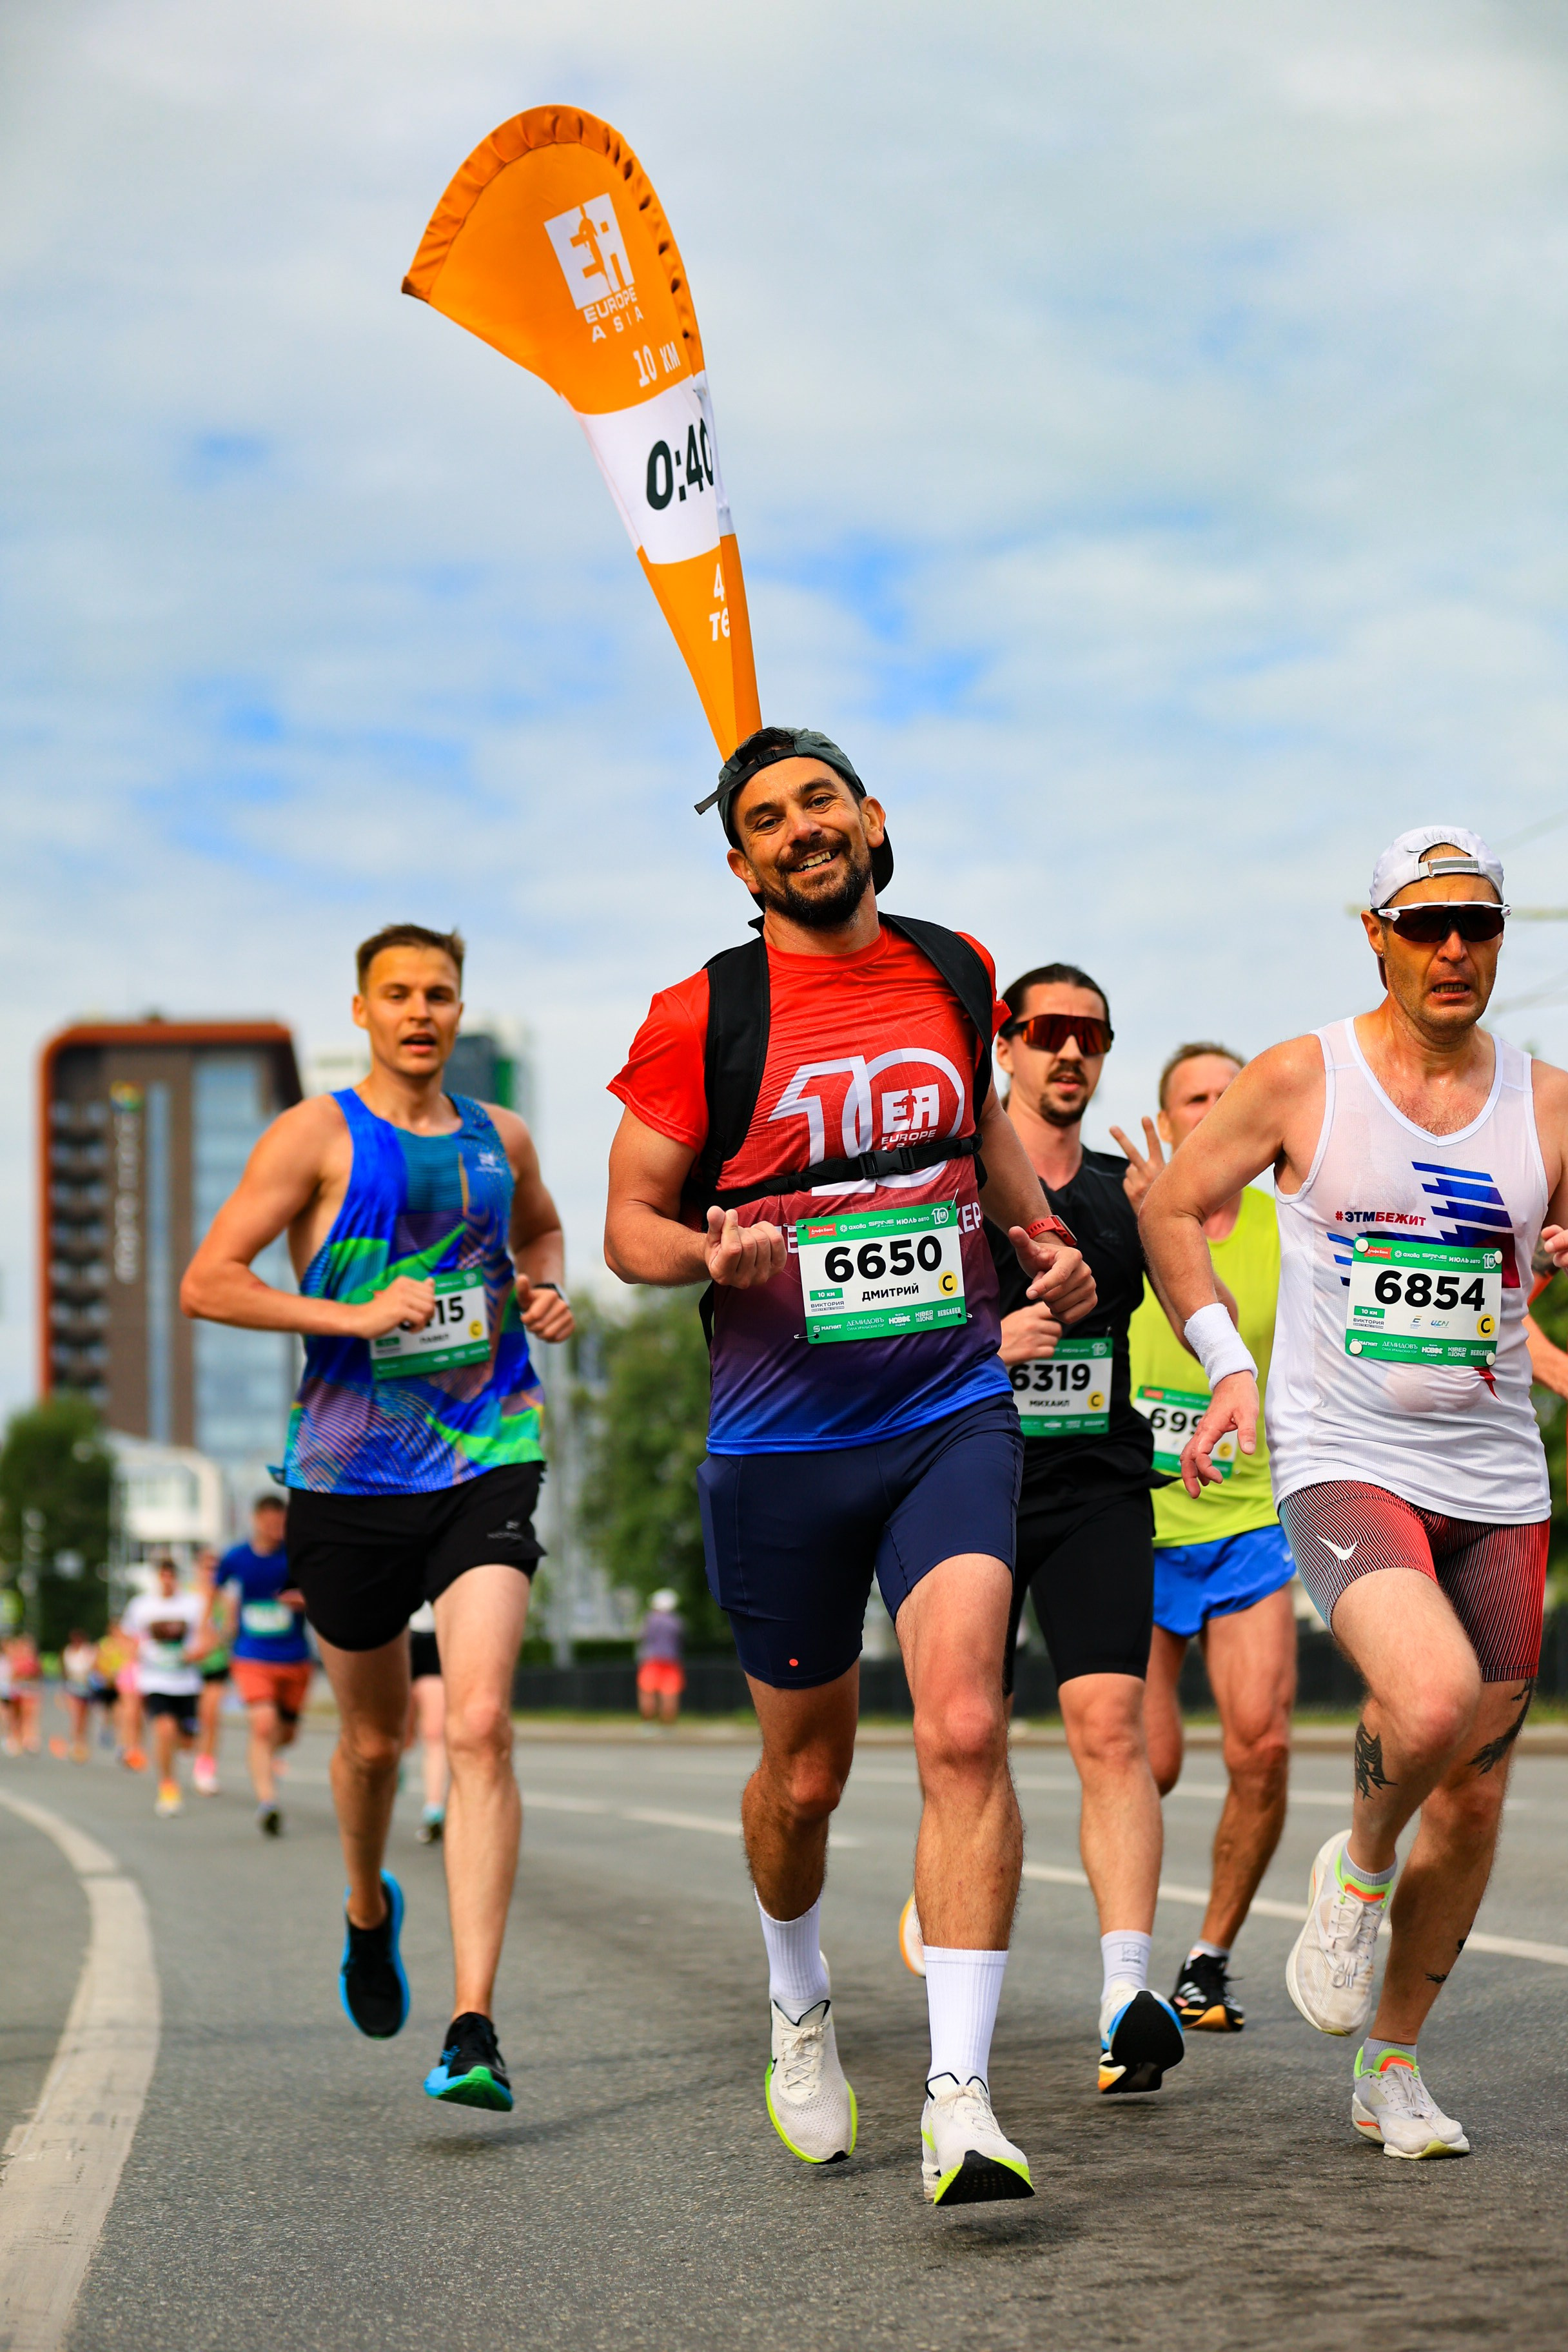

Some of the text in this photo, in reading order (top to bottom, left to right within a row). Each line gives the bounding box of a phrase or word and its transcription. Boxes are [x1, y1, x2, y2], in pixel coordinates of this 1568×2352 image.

[583, 286, 637, 324] EUROPE
[592, 306, 644, 343] ASIA
[633, 344, 657, 387] 10
[646, 417, 714, 511] 0:40
[767, 1047, 965, 1197] 10
[881, 1130, 937, 1145] EUROPE
[868, 1219, 894, 1227] SPINE
[931, 1207, 949, 1225] 10
[1335, 1210, 1427, 1226] #ЭТМБЕЖИТ
[825, 1235, 942, 1283] 6650
[861, 1282, 919, 1302] ДМИТРИЙ
[1375, 1269, 1485, 1311] 6854
[847, 1317, 885, 1327] ДЕМИДОВЪ
[1353, 1317, 1384, 1326] ВИКТОРИЯ
[1382, 1341, 1418, 1349] ДЕМИДОВЪ
[1010, 1363, 1091, 1391] 6319
[1150, 1408, 1204, 1435] 699
